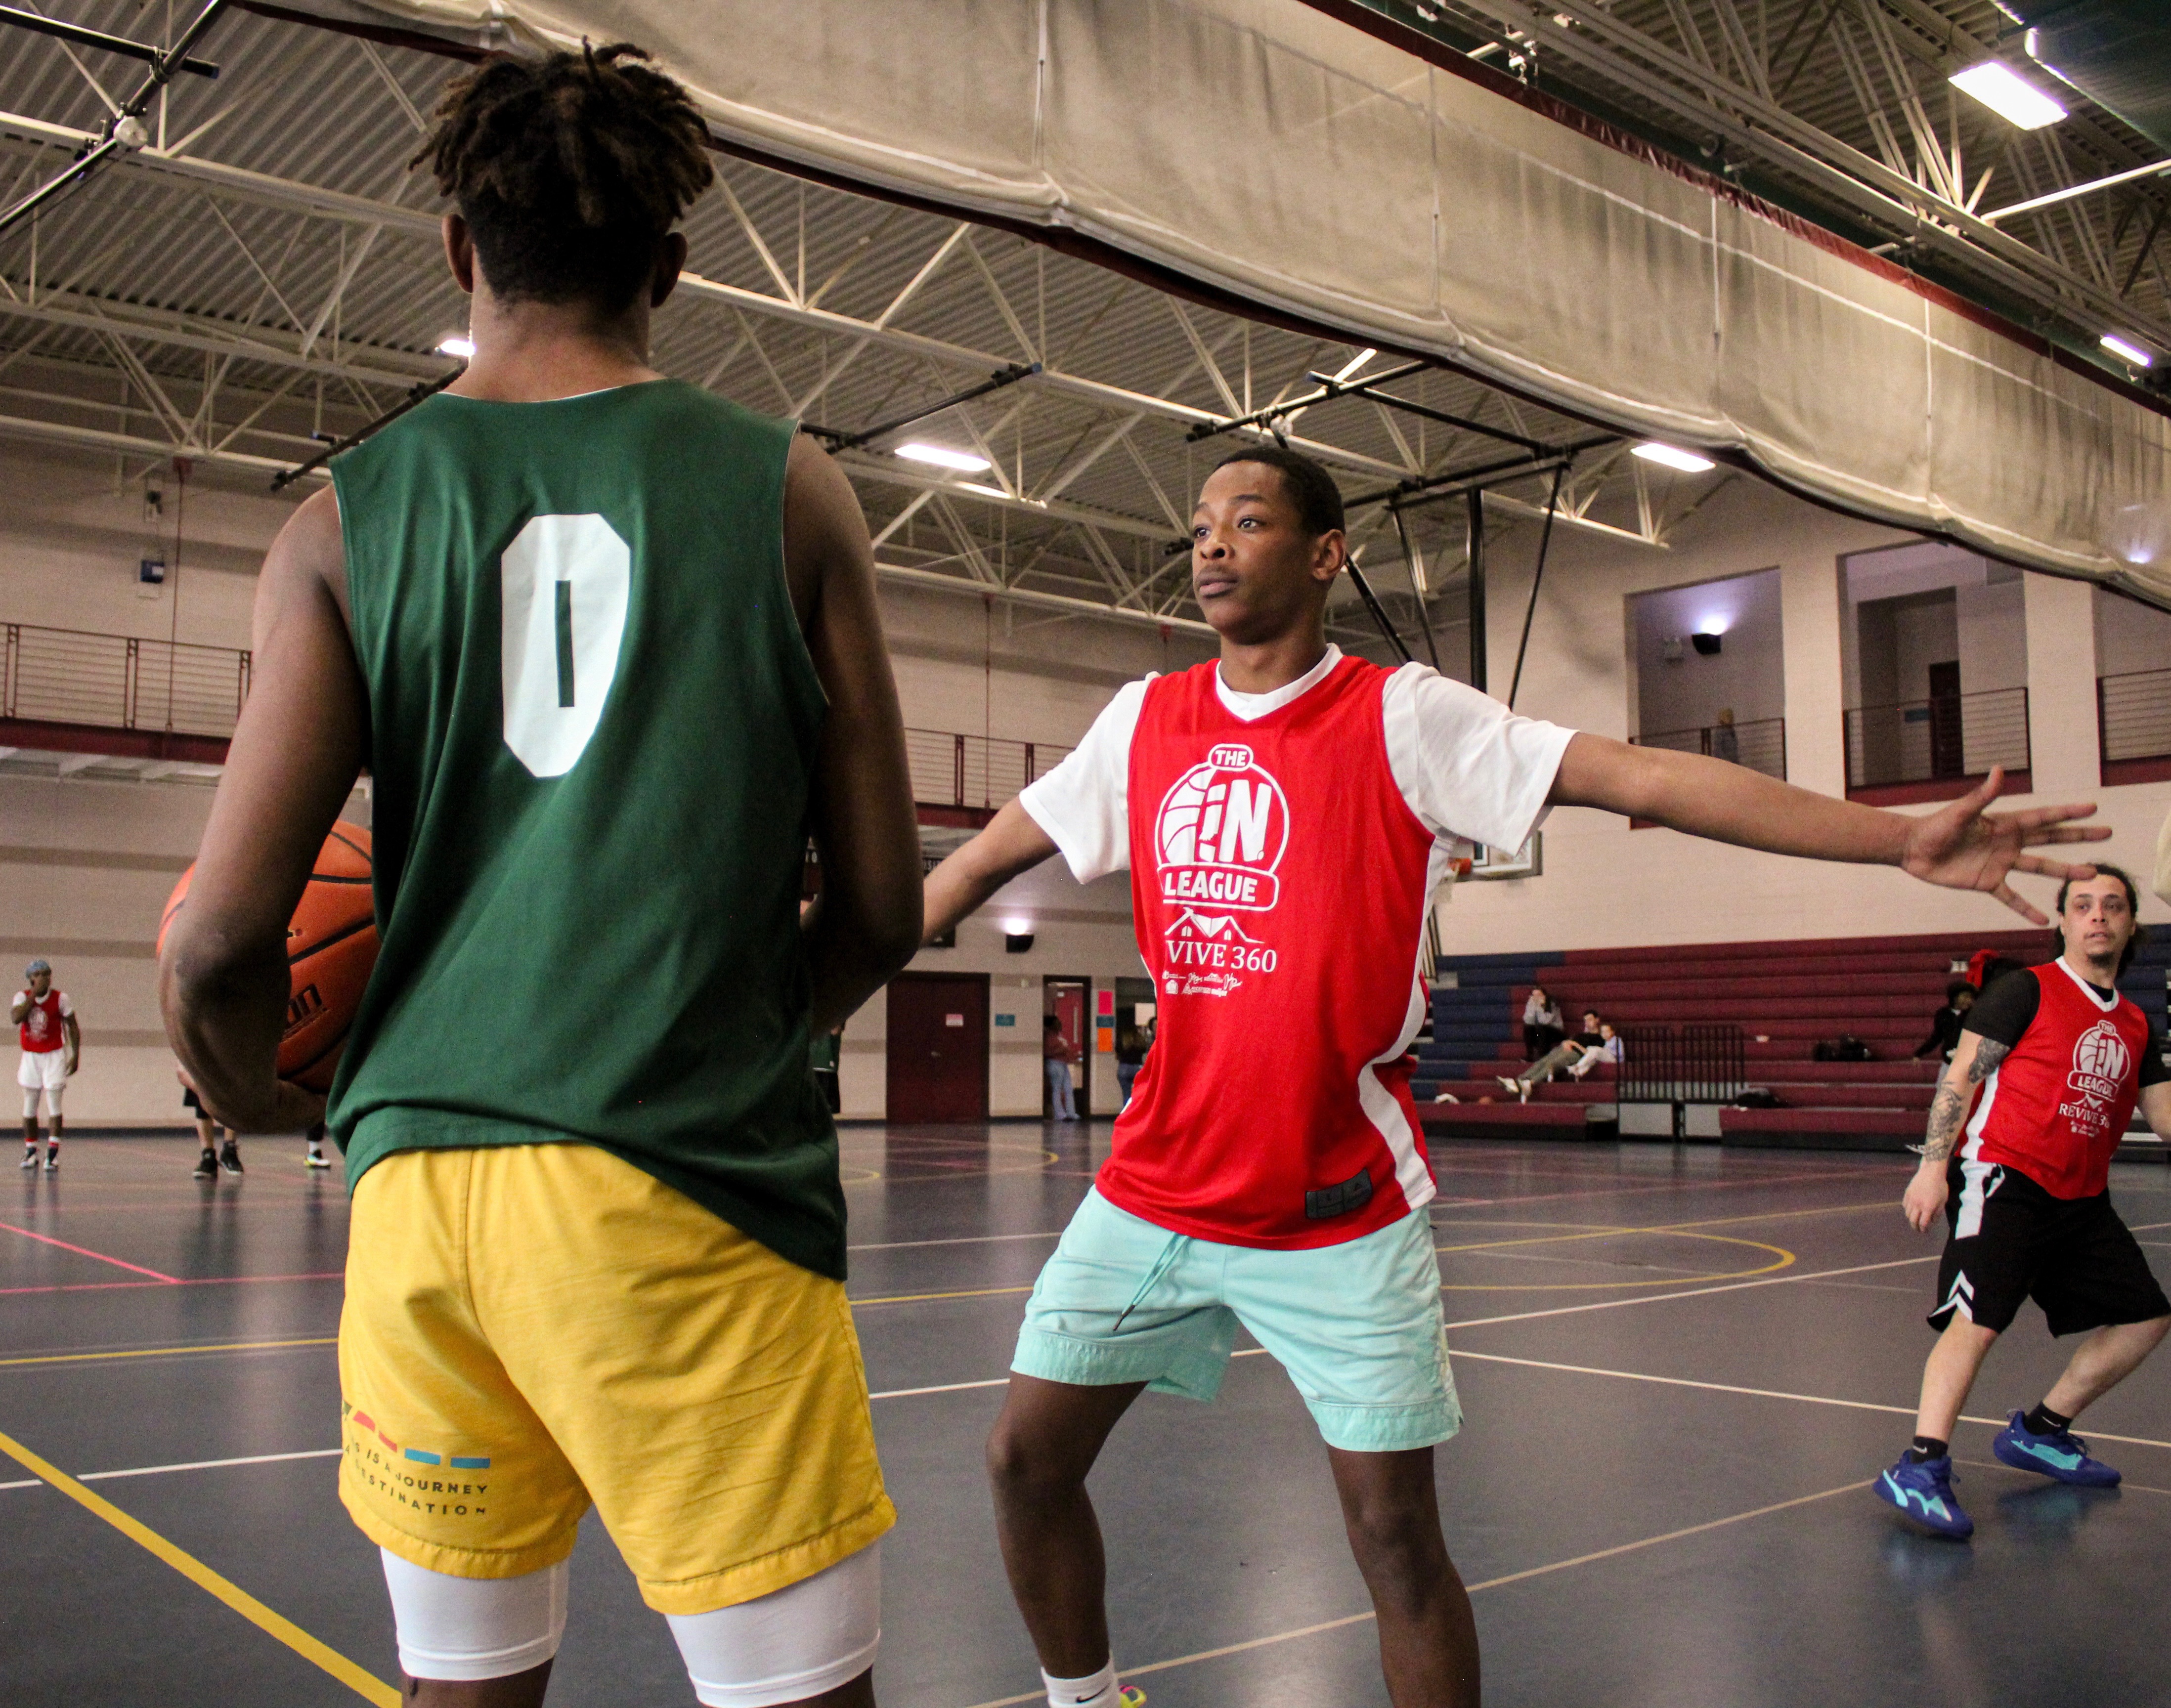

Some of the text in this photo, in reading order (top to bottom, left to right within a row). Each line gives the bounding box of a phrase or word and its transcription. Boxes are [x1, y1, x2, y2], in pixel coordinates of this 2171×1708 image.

[501, 513, 630, 777] 0
[1214, 750, 1248, 767] THE
[1165, 871, 1259, 902] LEAGUE
[1166, 940, 1277, 973] VIVE 360
[2078, 1075, 2114, 1097] LEAGUE
[2058, 1103, 2098, 1124] REVIVE
[366, 1449, 380, 1464] IS
[395, 1472, 488, 1494] JOURNEY
